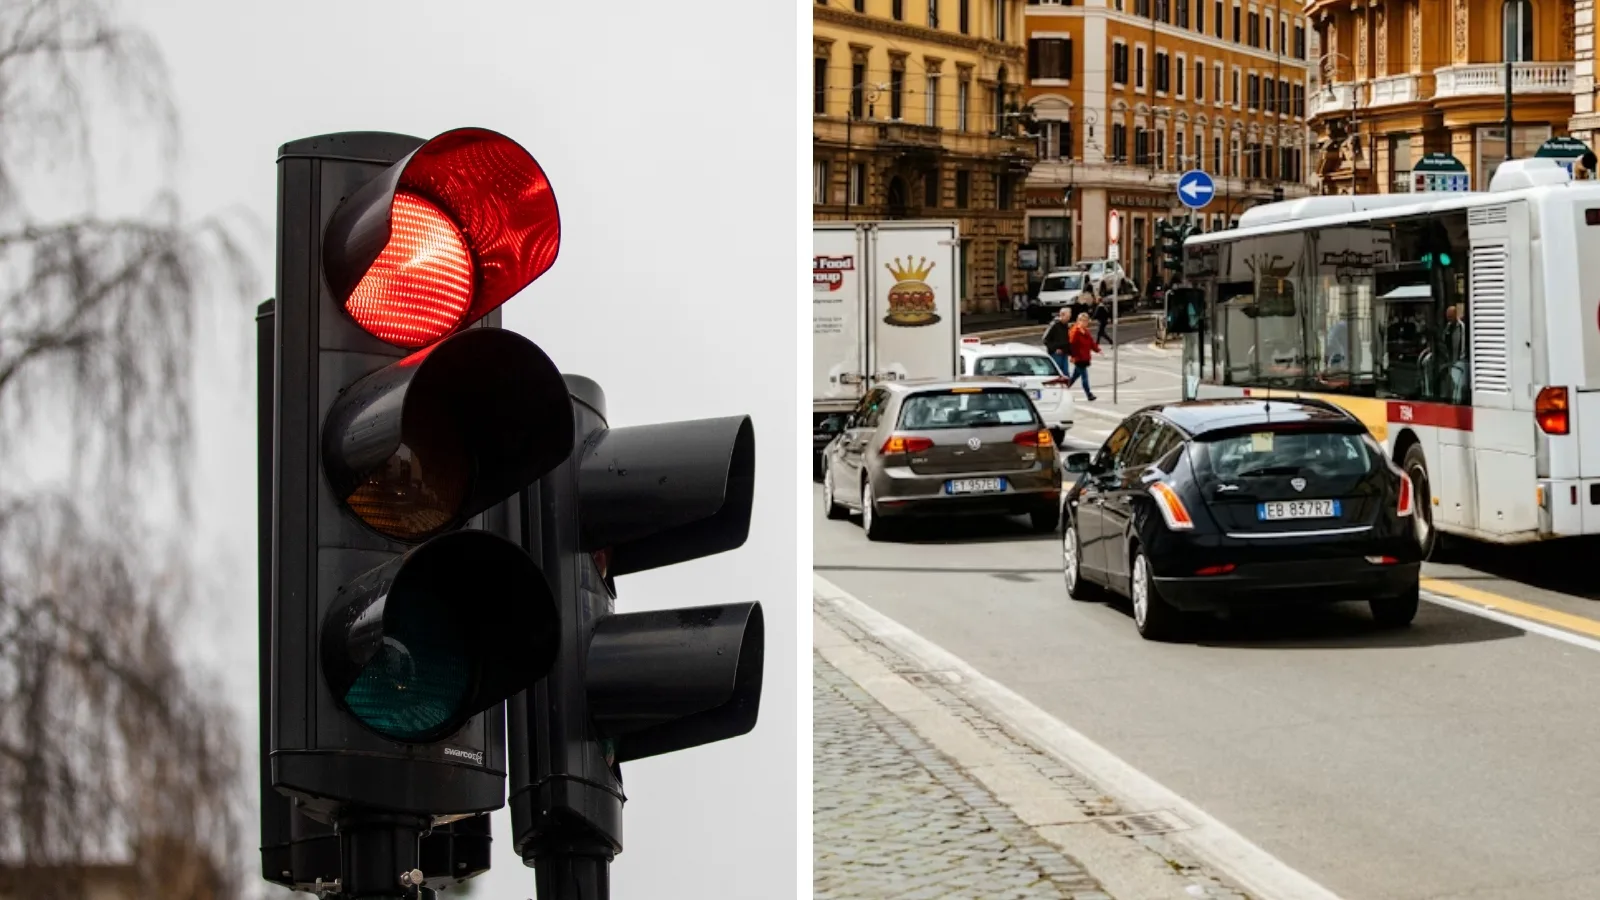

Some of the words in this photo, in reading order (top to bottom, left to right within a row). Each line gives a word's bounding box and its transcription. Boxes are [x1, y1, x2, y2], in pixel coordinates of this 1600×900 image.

[821, 258, 851, 269] Food
[1266, 502, 1284, 518] EB
[1288, 500, 1332, 516] 837RZ
[444, 747, 473, 759] swarco
